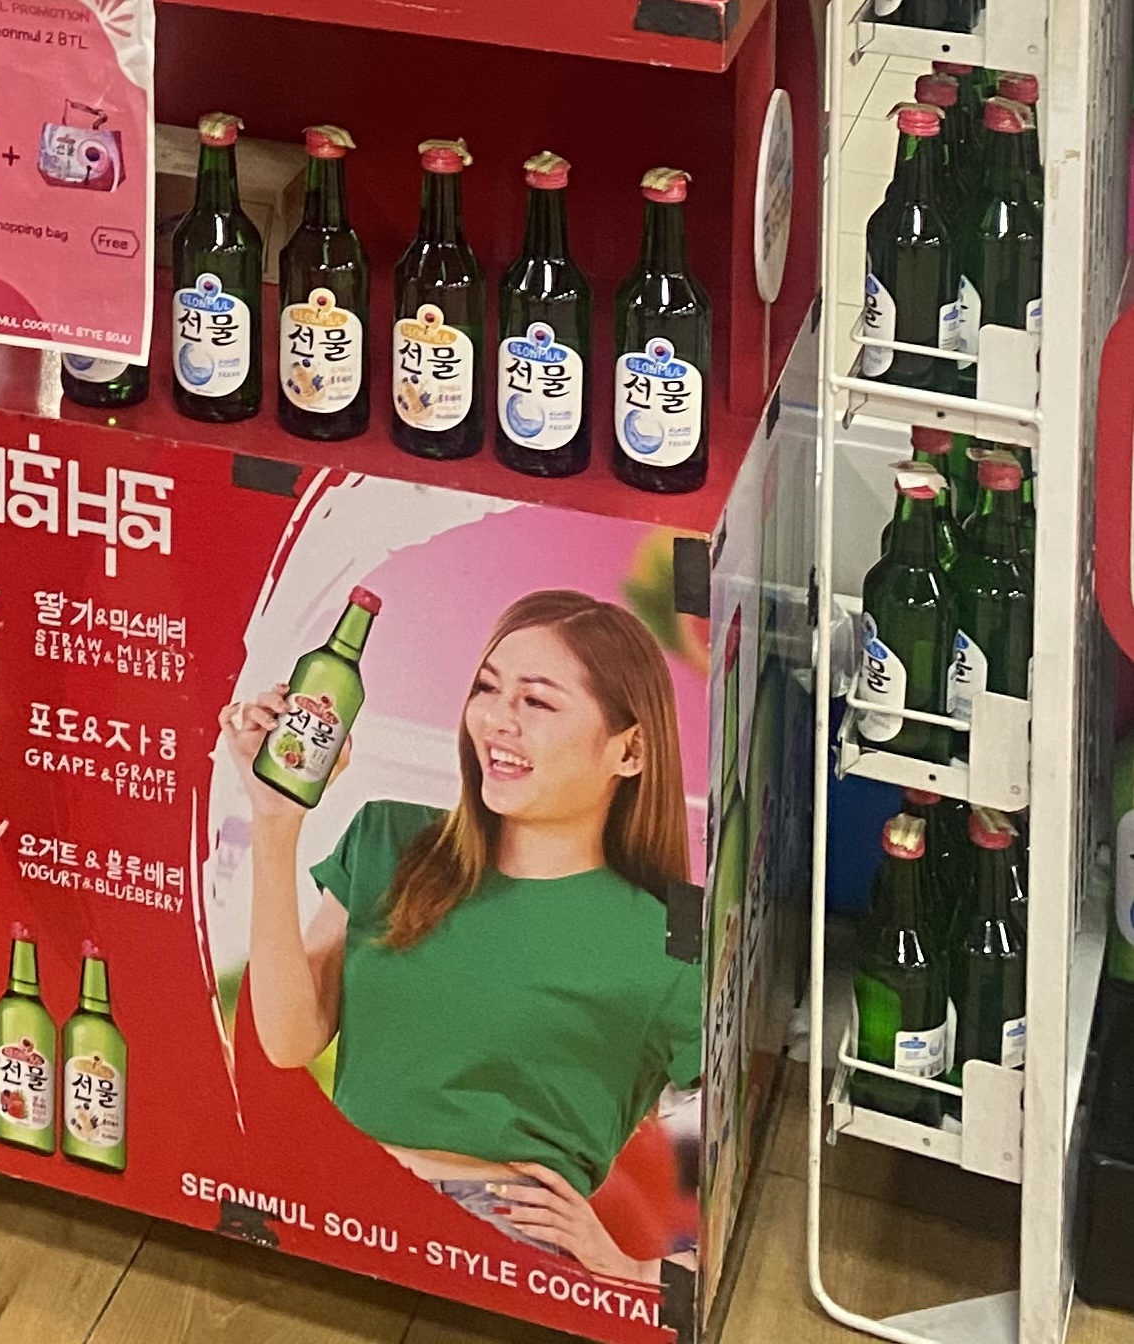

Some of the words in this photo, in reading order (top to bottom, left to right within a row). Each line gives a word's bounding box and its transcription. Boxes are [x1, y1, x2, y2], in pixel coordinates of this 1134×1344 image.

[12, 2, 90, 23] PROMOTION
[45, 31, 54, 45] 2
[58, 32, 89, 50] BTL
[46, 226, 69, 242] bag
[98, 233, 129, 250] Free
[177, 308, 240, 346] 선물
[287, 324, 353, 362] 선물
[398, 339, 462, 380] 선물
[505, 357, 573, 398] 선물
[622, 373, 692, 414] 선물
[34, 628, 103, 653] STRAW
[34, 642, 101, 667] BERRY
[117, 644, 186, 668] MIXED
[117, 659, 185, 683] BERRY
[285, 707, 335, 750] 선물
[24, 747, 96, 777] GRAPE
[115, 761, 176, 787] GRAPE
[116, 778, 176, 804] FRUIT
[17, 833, 79, 867] 요거트
[0, 1058, 49, 1092] 선물
[71, 1072, 119, 1110] 선물
[181, 1171, 316, 1233] SEONMUL
[323, 1210, 399, 1254] SOJU
[425, 1240, 518, 1288] STYLE
[527, 1269, 669, 1330] COCKTAI
